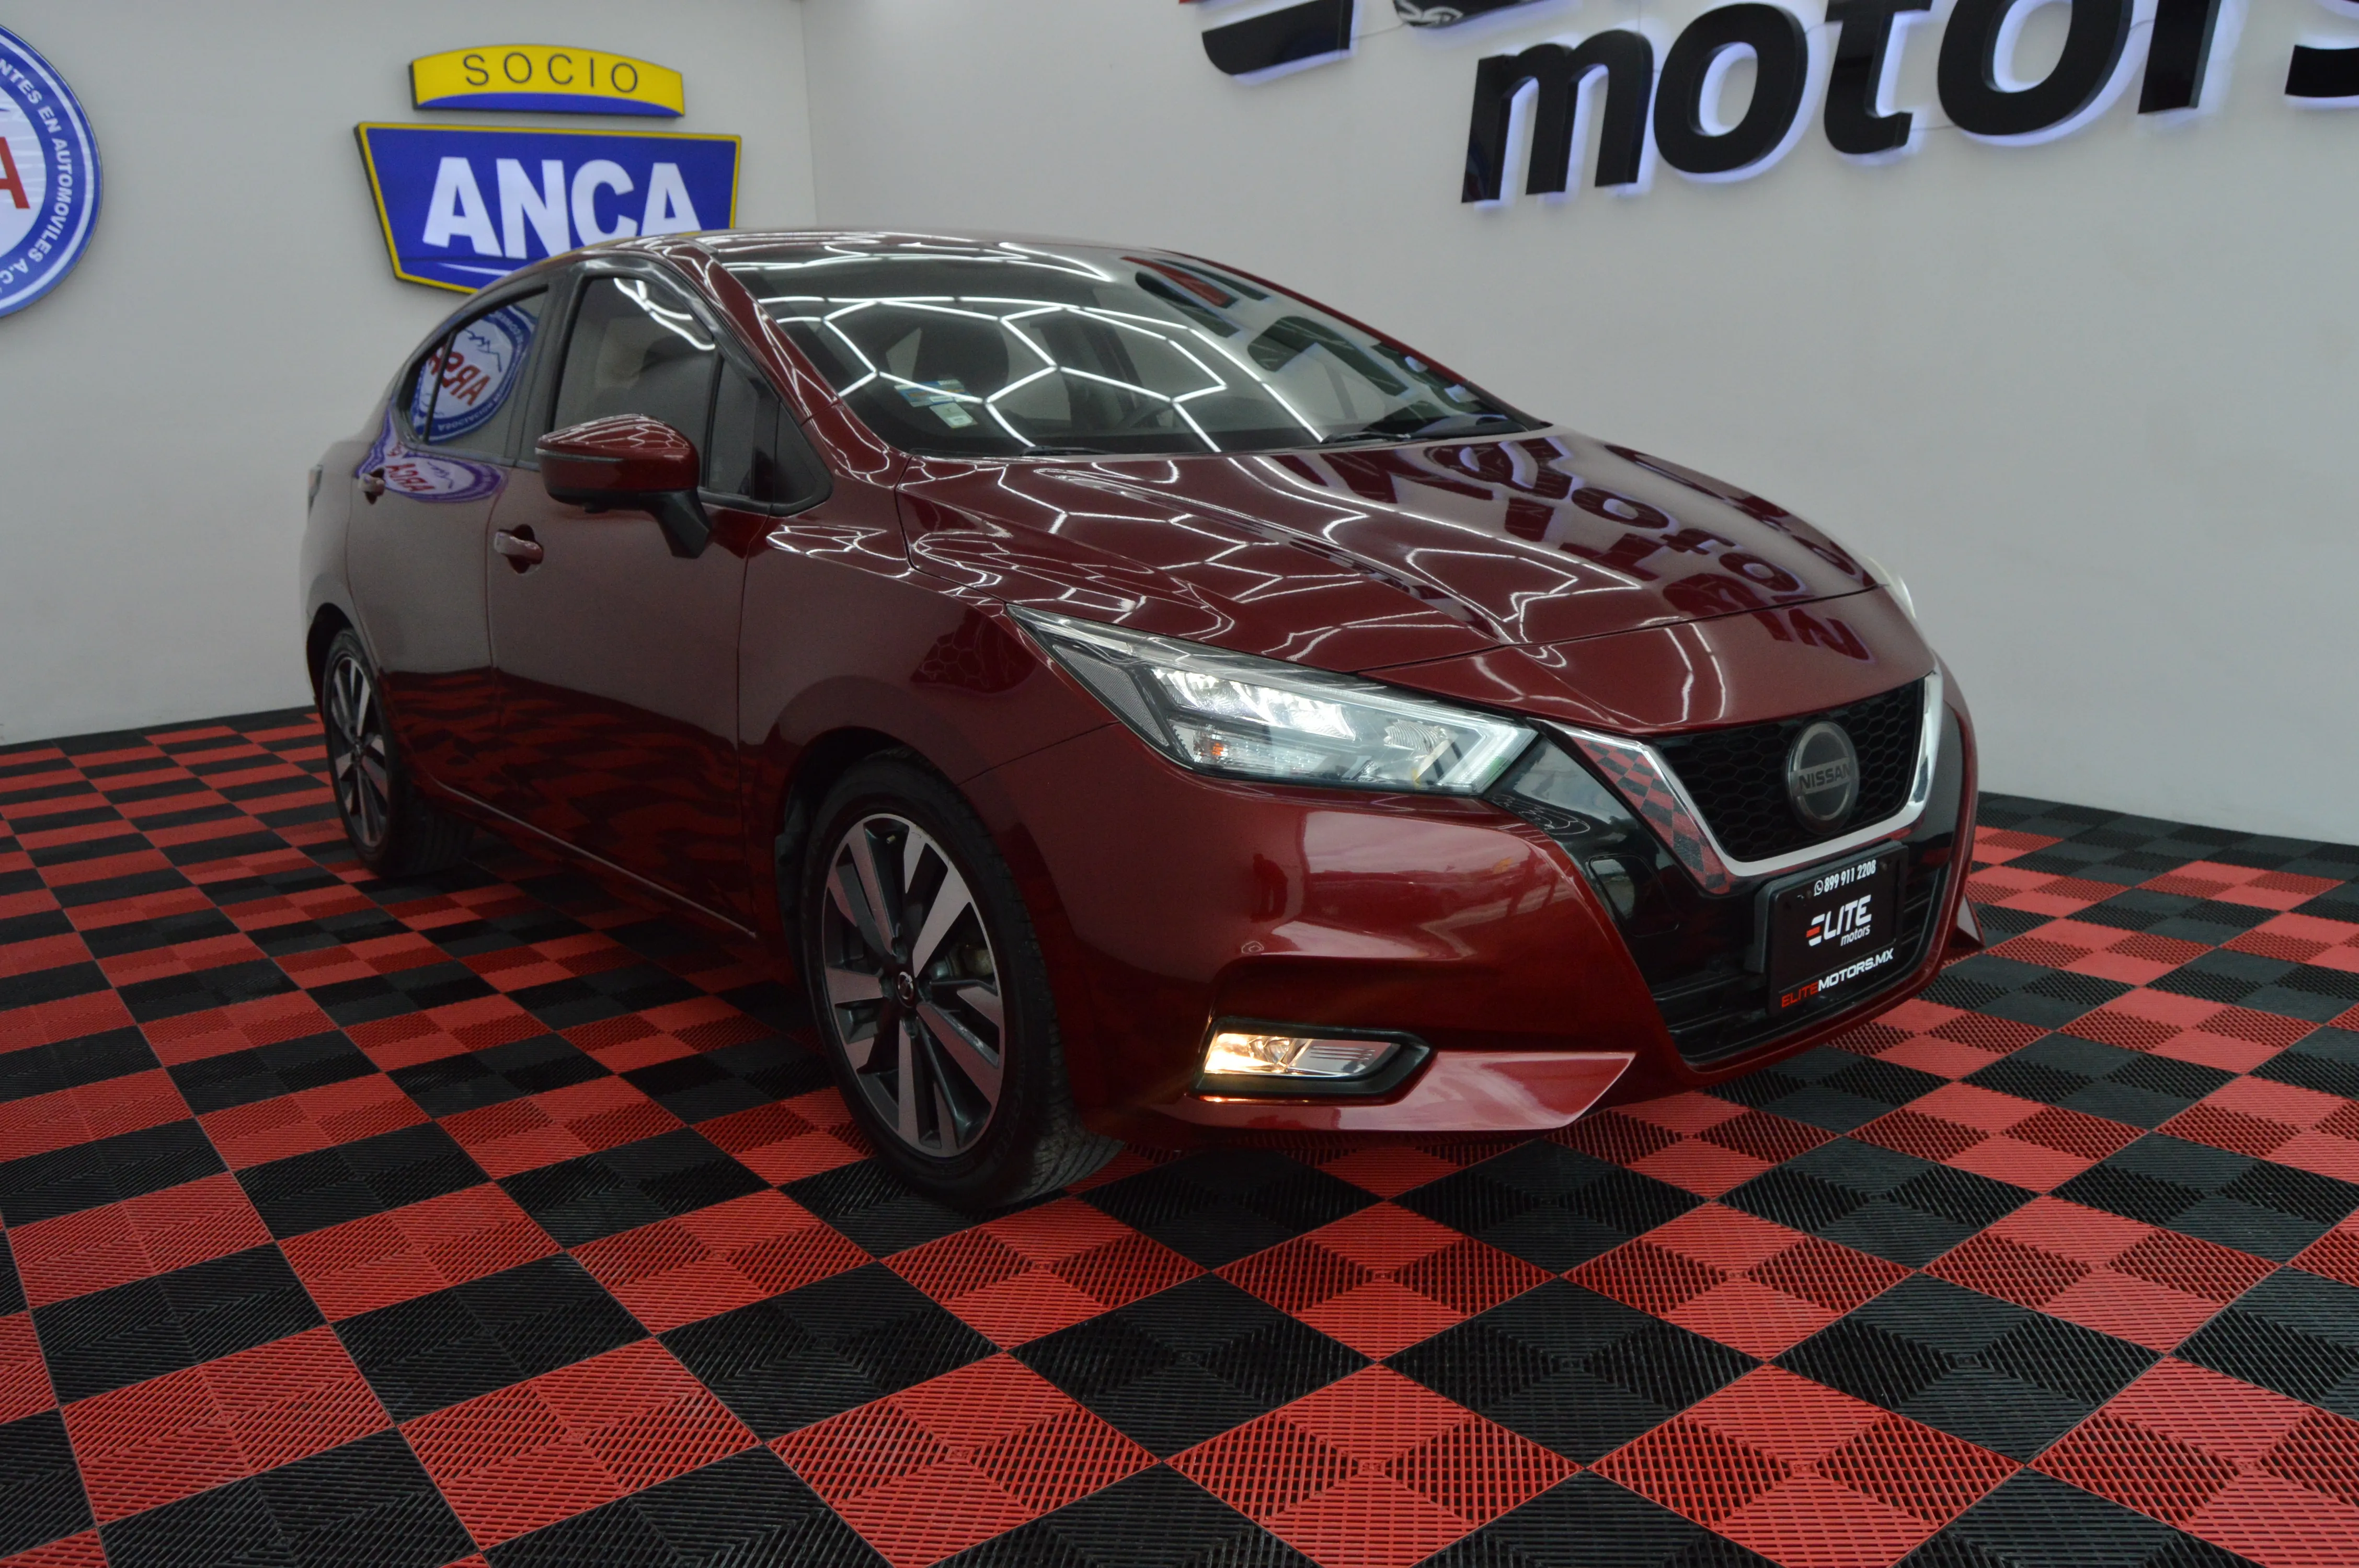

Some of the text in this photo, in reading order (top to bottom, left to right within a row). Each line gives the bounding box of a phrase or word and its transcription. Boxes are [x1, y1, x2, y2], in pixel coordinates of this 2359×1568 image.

[463, 52, 638, 93] SOCIO
[38, 106, 62, 134] EN
[28, 138, 73, 263] AUTOMOVILES
[422, 156, 702, 260] ANCA
[1799, 762, 1851, 789] NISSAN
[1824, 859, 1876, 893] 899 911 2208
[1806, 894, 1872, 947] ELITE
[1840, 925, 1871, 947] motors
[1782, 948, 1894, 1008] ELITEMOTORS.MX
